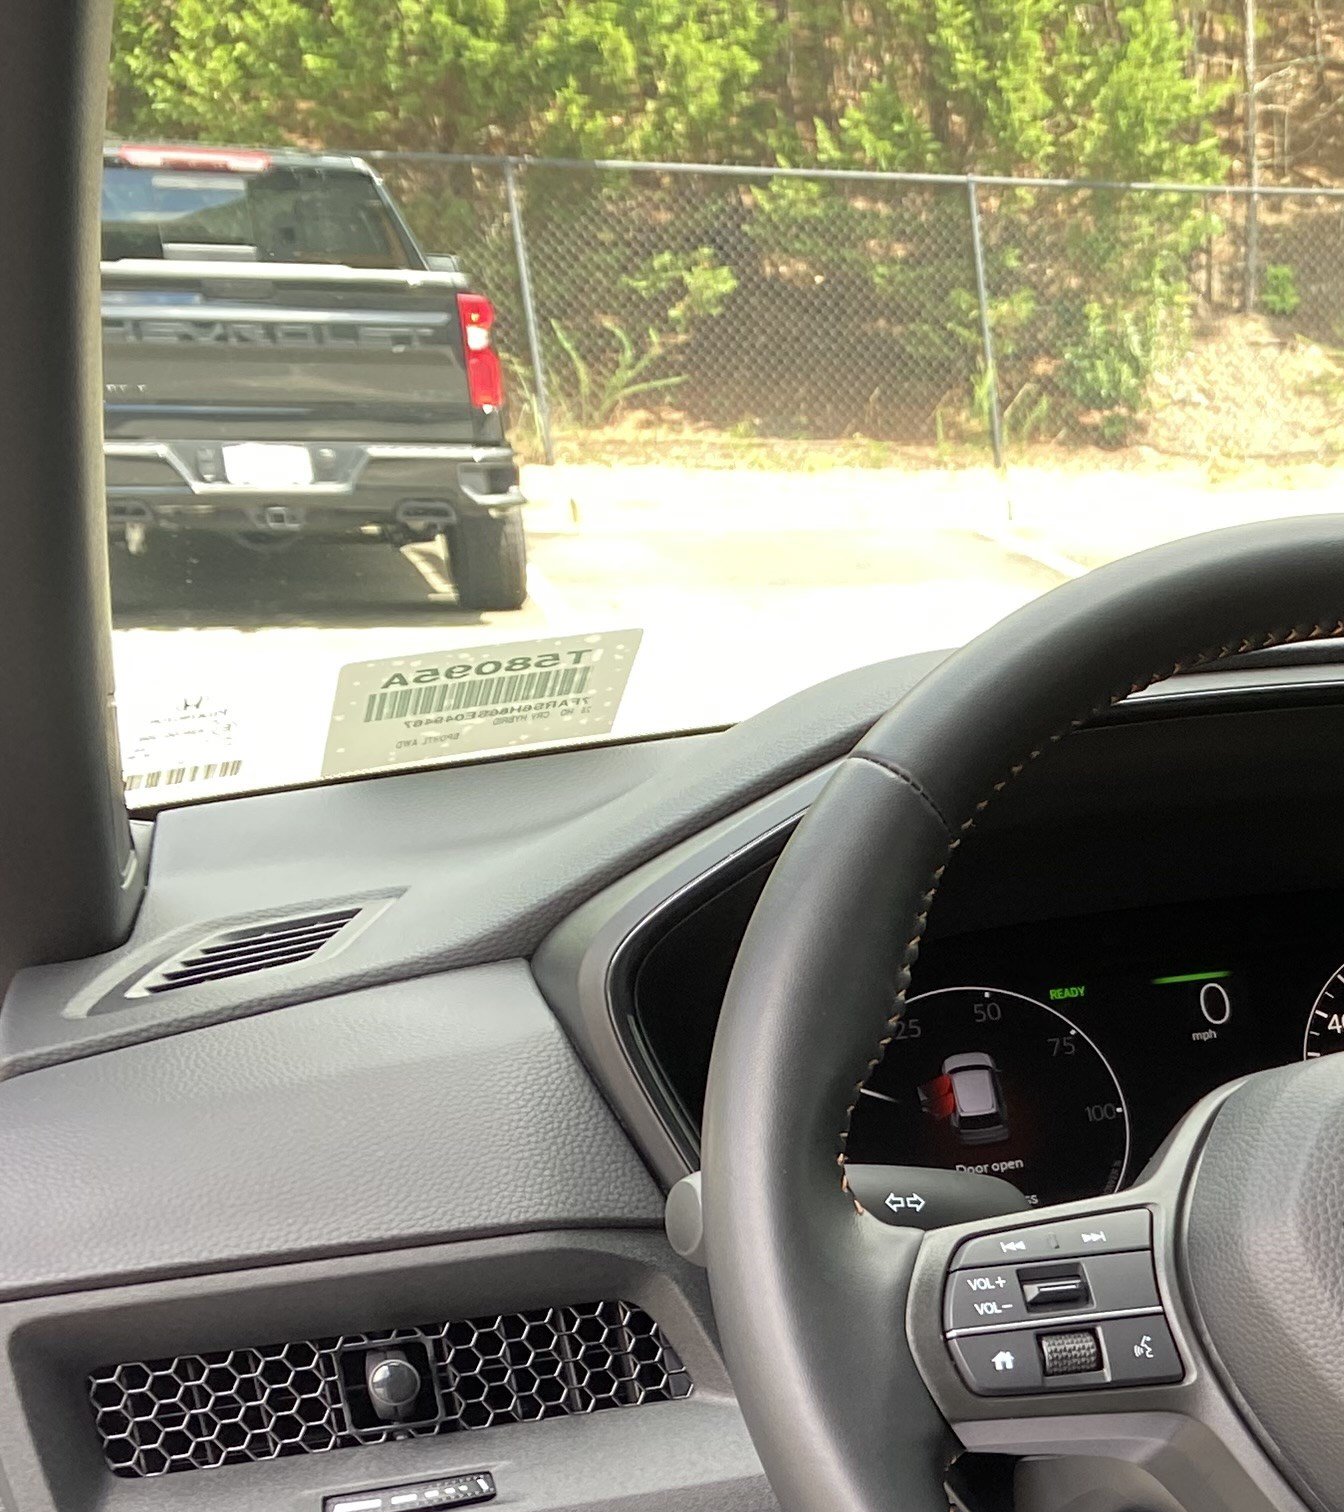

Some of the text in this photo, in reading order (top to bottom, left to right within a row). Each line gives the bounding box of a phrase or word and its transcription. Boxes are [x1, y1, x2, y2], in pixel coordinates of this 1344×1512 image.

[103, 319, 434, 350] HEVROLET
[1049, 985, 1086, 1000] READY
[973, 1002, 1002, 1023] 50
[1200, 982, 1231, 1025] 0
[895, 1018, 922, 1041] 25
[1191, 1029, 1218, 1043] mph
[1048, 1036, 1076, 1057] 75
[1084, 1103, 1118, 1122] 100
[955, 1158, 1024, 1176] Door open
[967, 1276, 1007, 1291] VOL+
